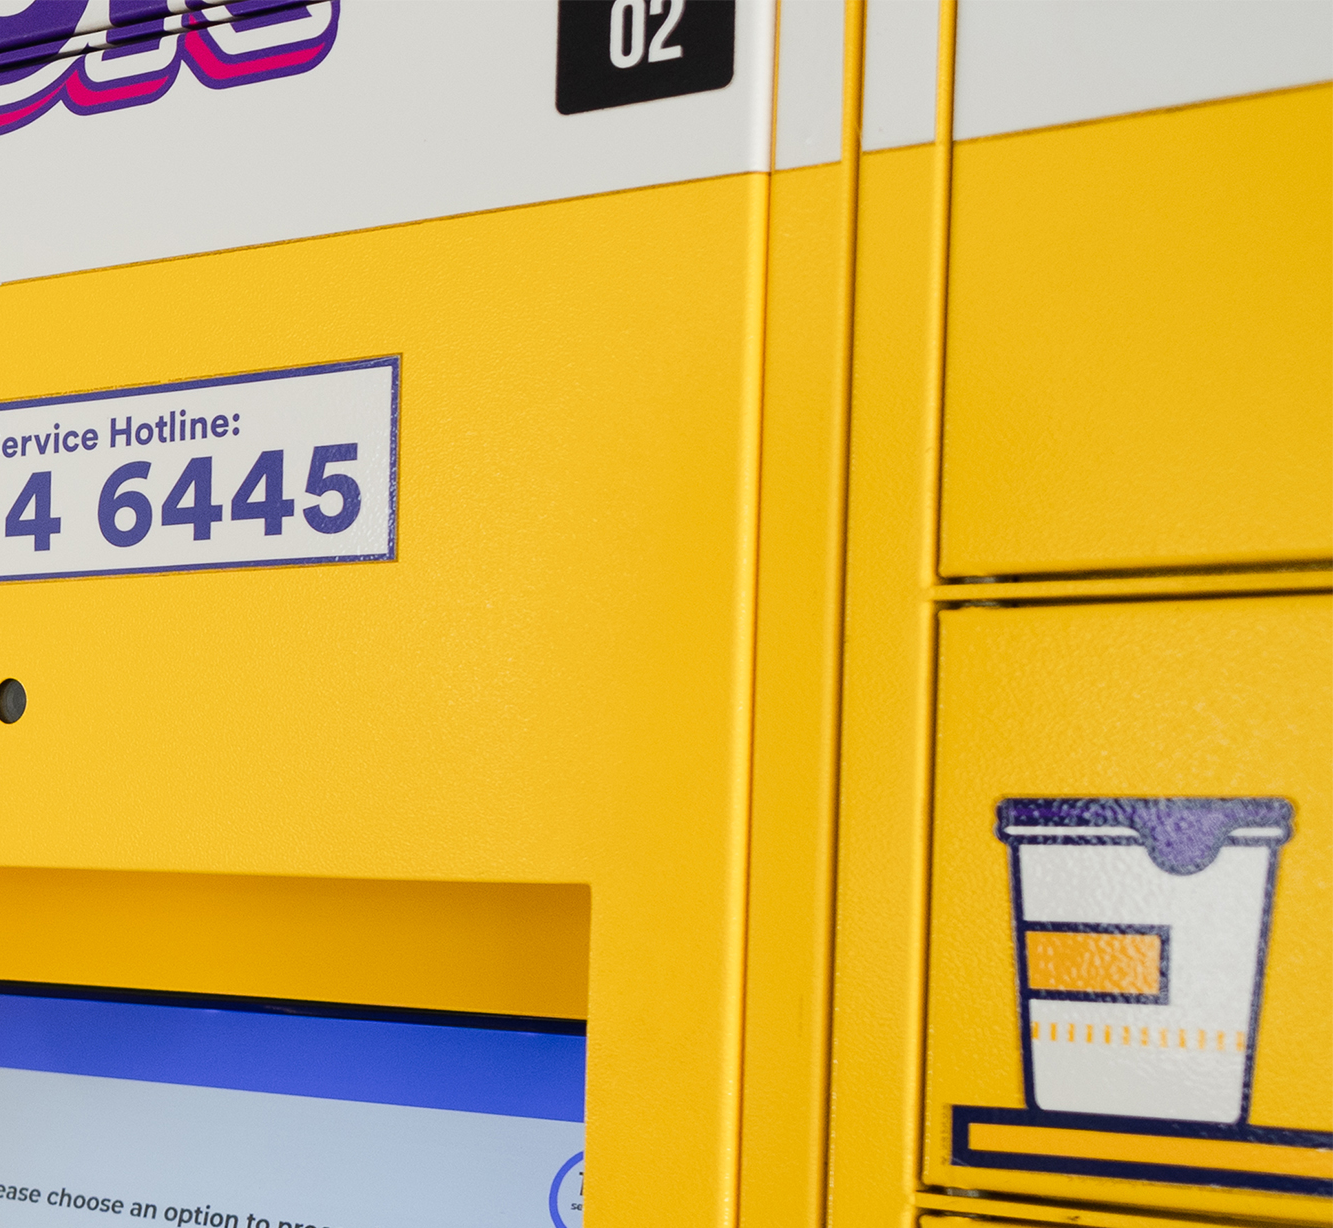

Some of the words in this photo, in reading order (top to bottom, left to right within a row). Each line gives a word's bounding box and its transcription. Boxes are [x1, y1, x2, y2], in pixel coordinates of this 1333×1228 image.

[609, 0, 684, 69] 02
[109, 409, 241, 449] Hotline:
[97, 442, 363, 549] 6445
[46, 1188, 124, 1214] choose
[129, 1201, 158, 1219] an
